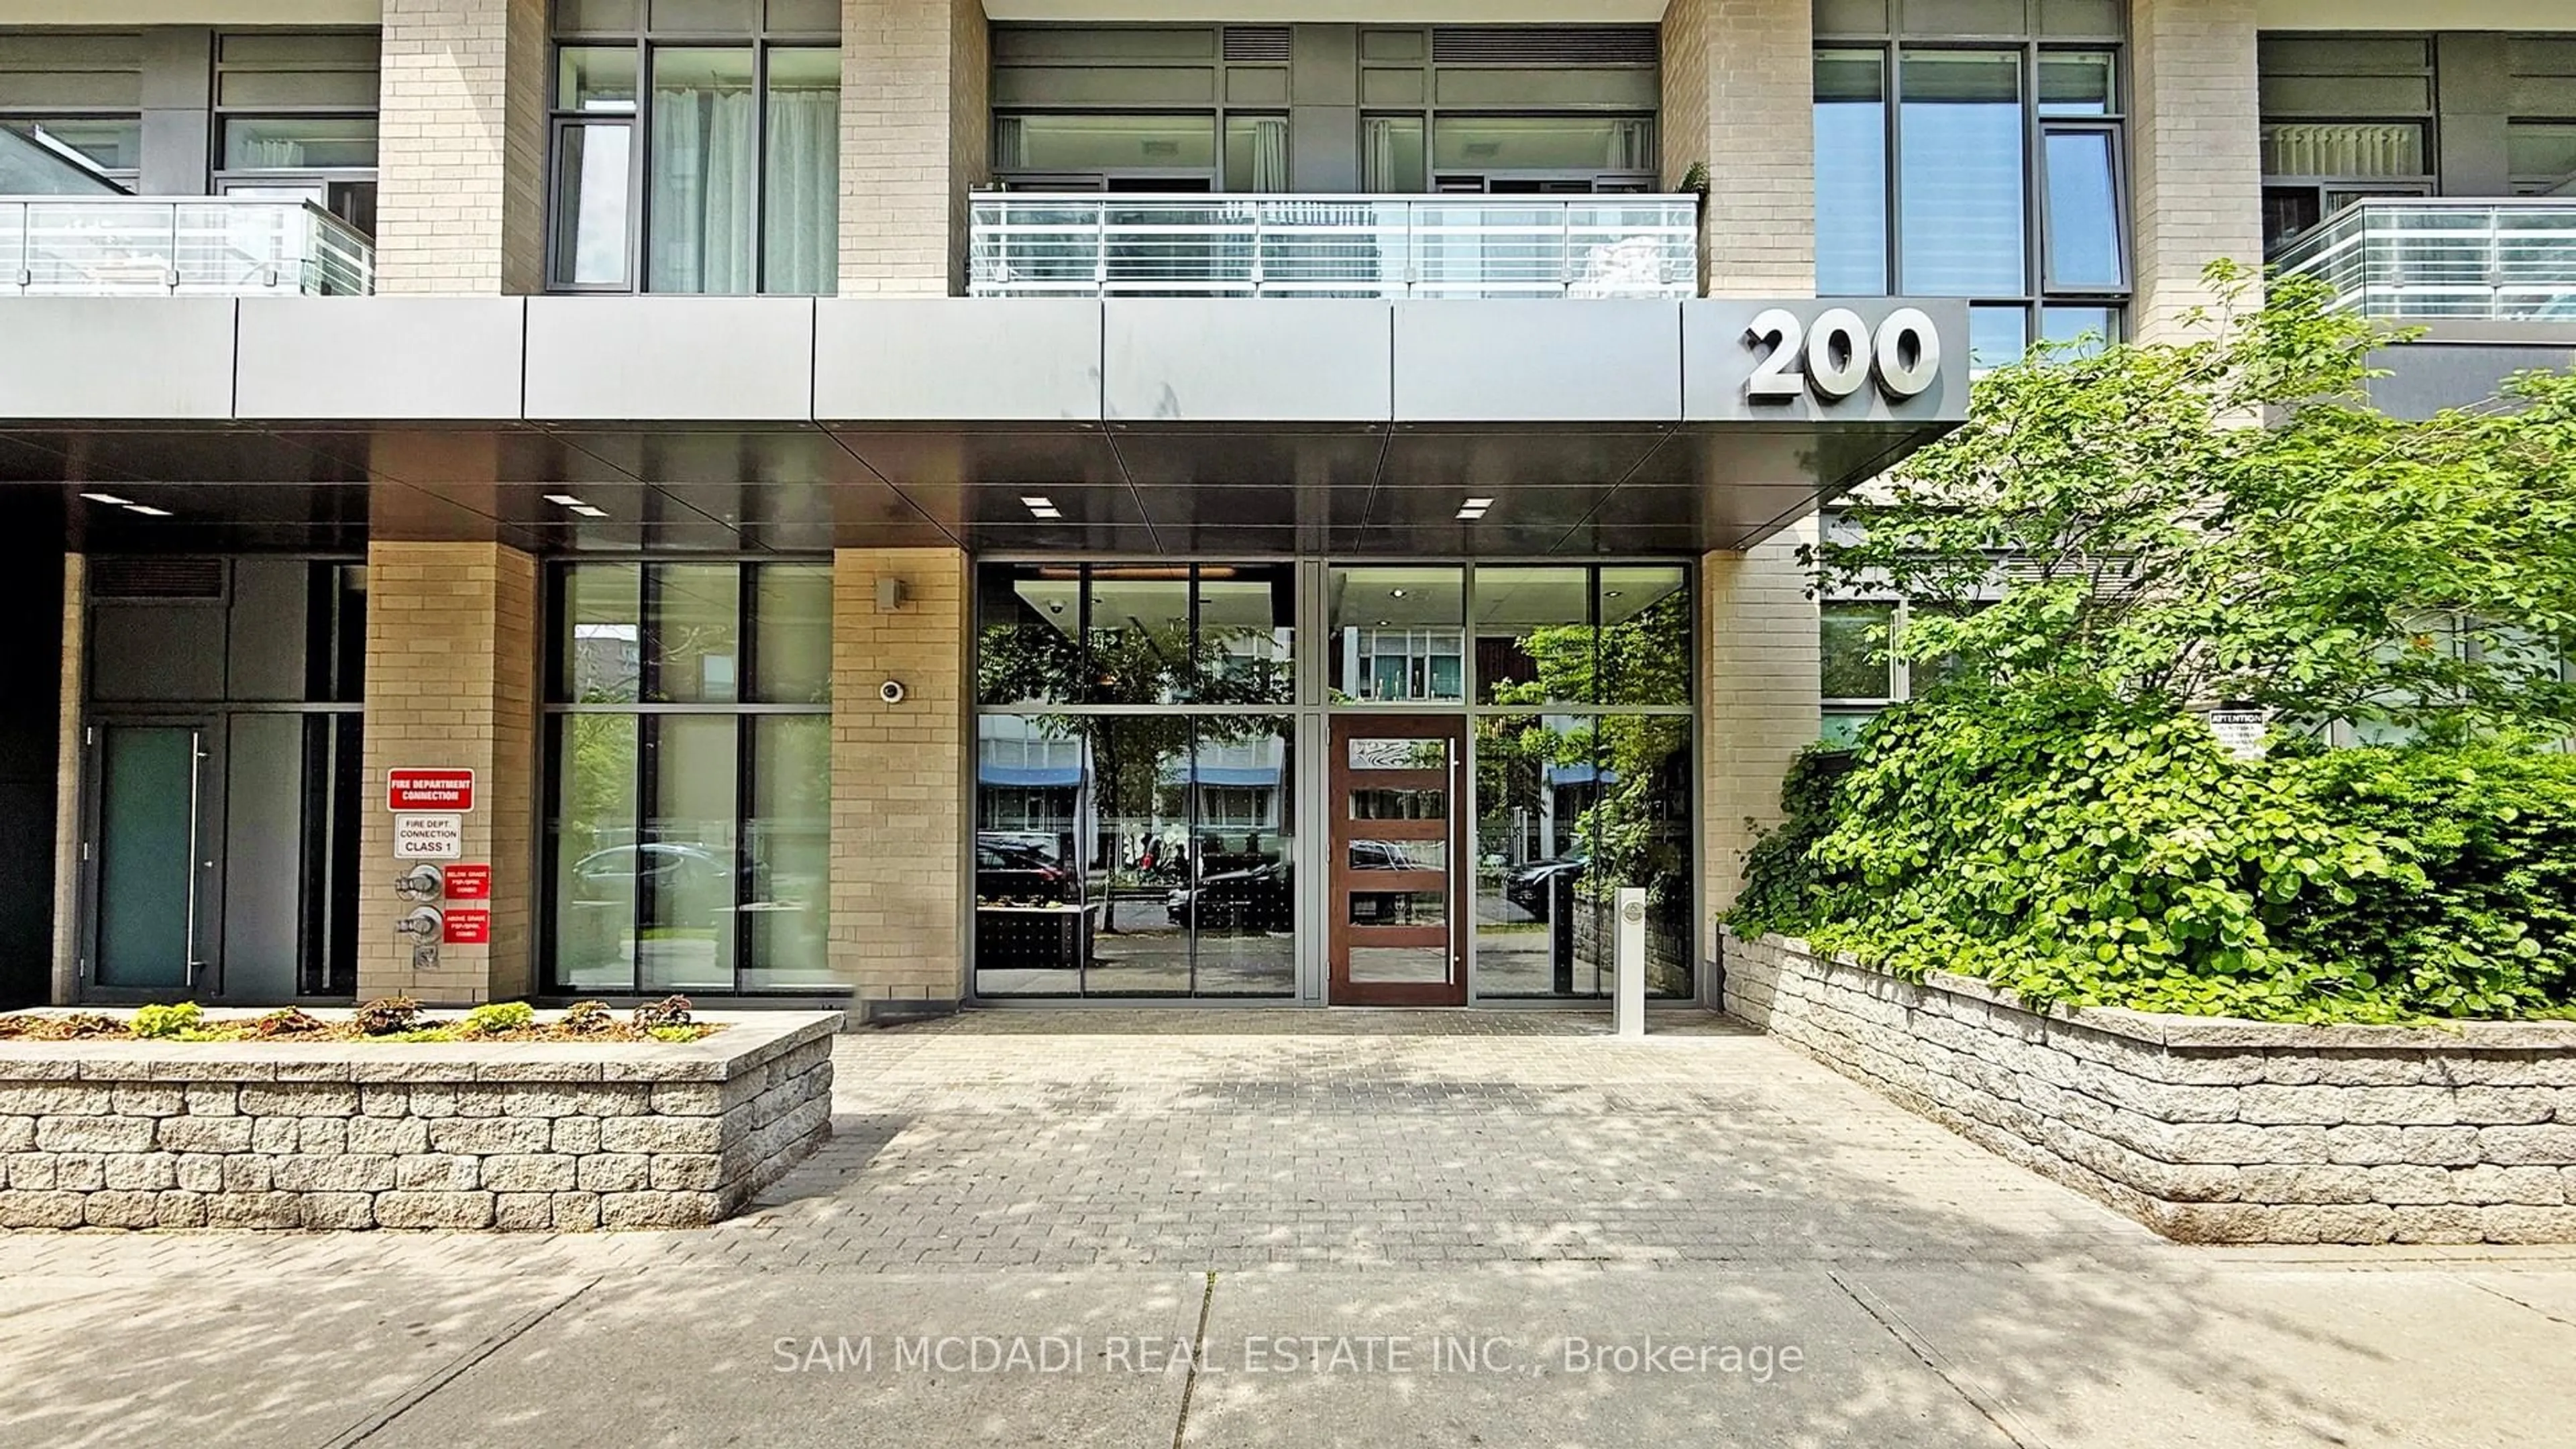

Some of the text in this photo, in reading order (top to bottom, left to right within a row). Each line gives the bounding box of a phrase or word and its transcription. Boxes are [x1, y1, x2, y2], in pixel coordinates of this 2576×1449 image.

[1746, 308, 1940, 401] 200
[2212, 714, 2261, 722] ATTENTION
[392, 780, 470, 789] FIRE DEPARTMENT
[402, 791, 459, 800] CONNECTION
[405, 842, 451, 852] CLASS 1
